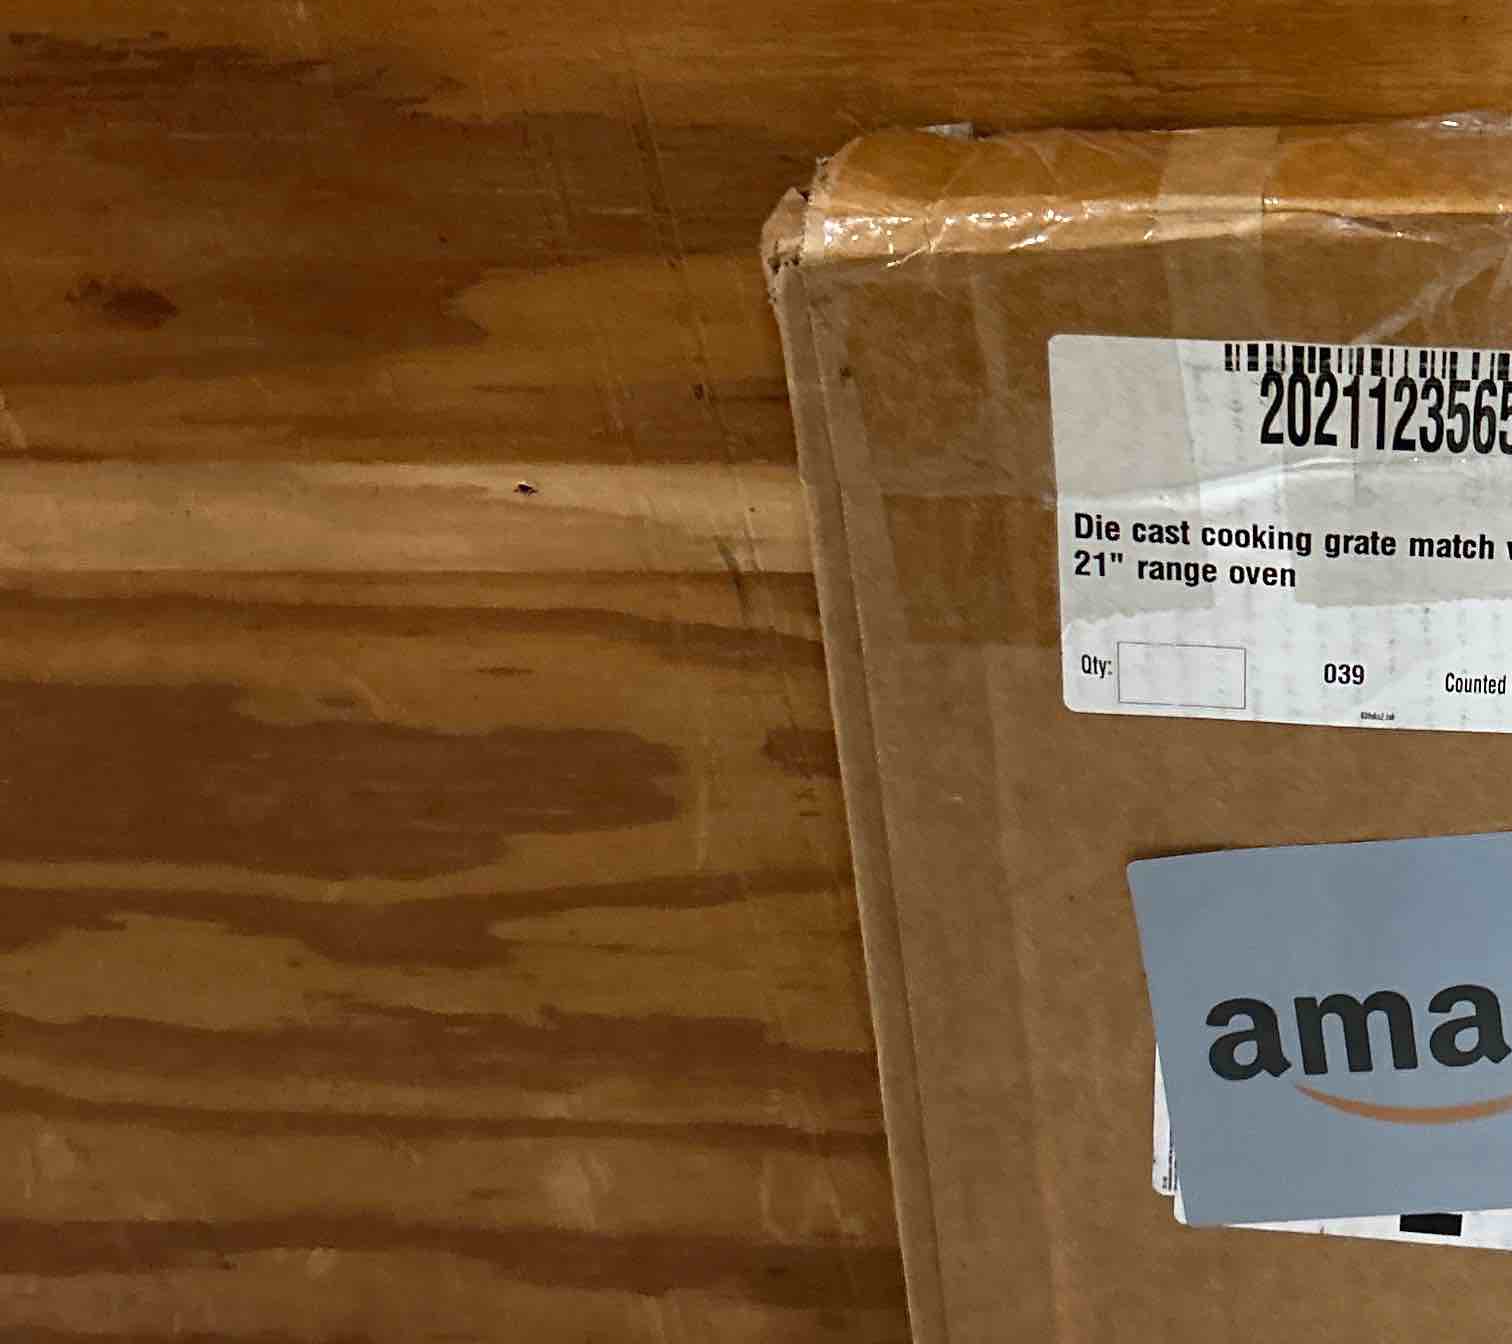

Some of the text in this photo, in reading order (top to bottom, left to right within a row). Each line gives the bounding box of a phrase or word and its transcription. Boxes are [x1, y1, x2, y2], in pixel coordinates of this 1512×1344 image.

[1074, 513, 1120, 541] Die
[1133, 521, 1191, 545] cast
[1201, 524, 1312, 557] cooking
[1325, 531, 1396, 558] grate
[1409, 534, 1494, 559] match
[1074, 550, 1296, 587] 21" range oven
[1081, 654, 1112, 679] Qty:
[1324, 663, 1365, 685] 039
[1445, 673, 1506, 695] Counted
